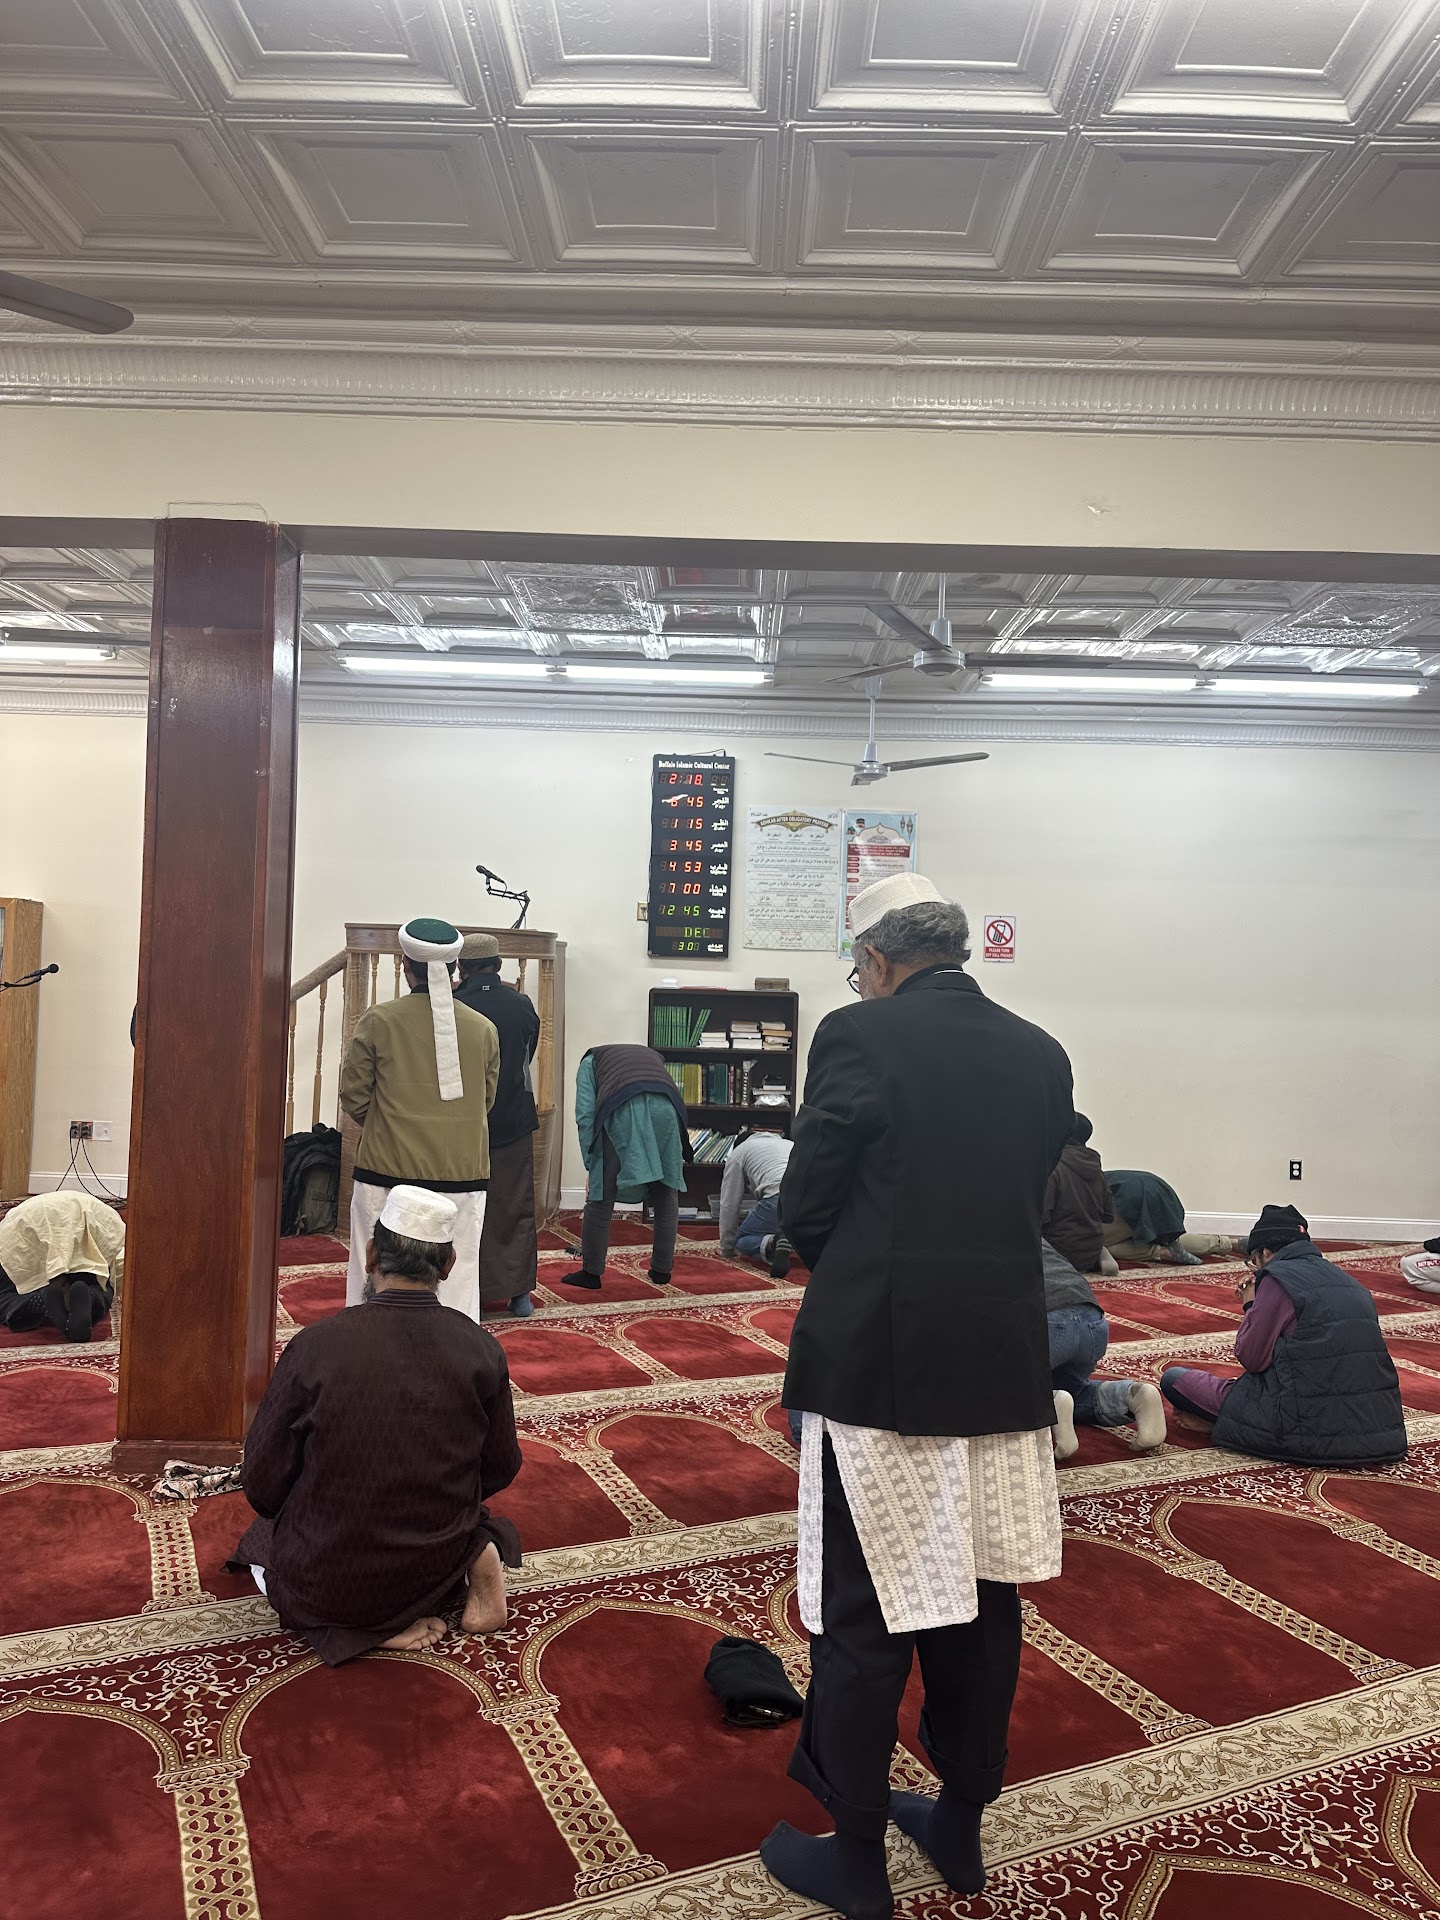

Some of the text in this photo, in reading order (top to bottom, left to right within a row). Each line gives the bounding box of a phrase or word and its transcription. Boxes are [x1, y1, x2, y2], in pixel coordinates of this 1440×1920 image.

[659, 760, 730, 770] Buffalo Islamic Cultural Center
[669, 773, 703, 786] 2:18
[687, 796, 704, 808] 45
[689, 818, 703, 830] 15
[788, 816, 812, 824] OBLIGATORY
[670, 840, 702, 852] 3 45
[669, 861, 702, 873] 4 53
[669, 882, 702, 895] 7 00
[683, 905, 700, 917] 45
[683, 926, 711, 938] DEC
[678, 941, 694, 951] 30
